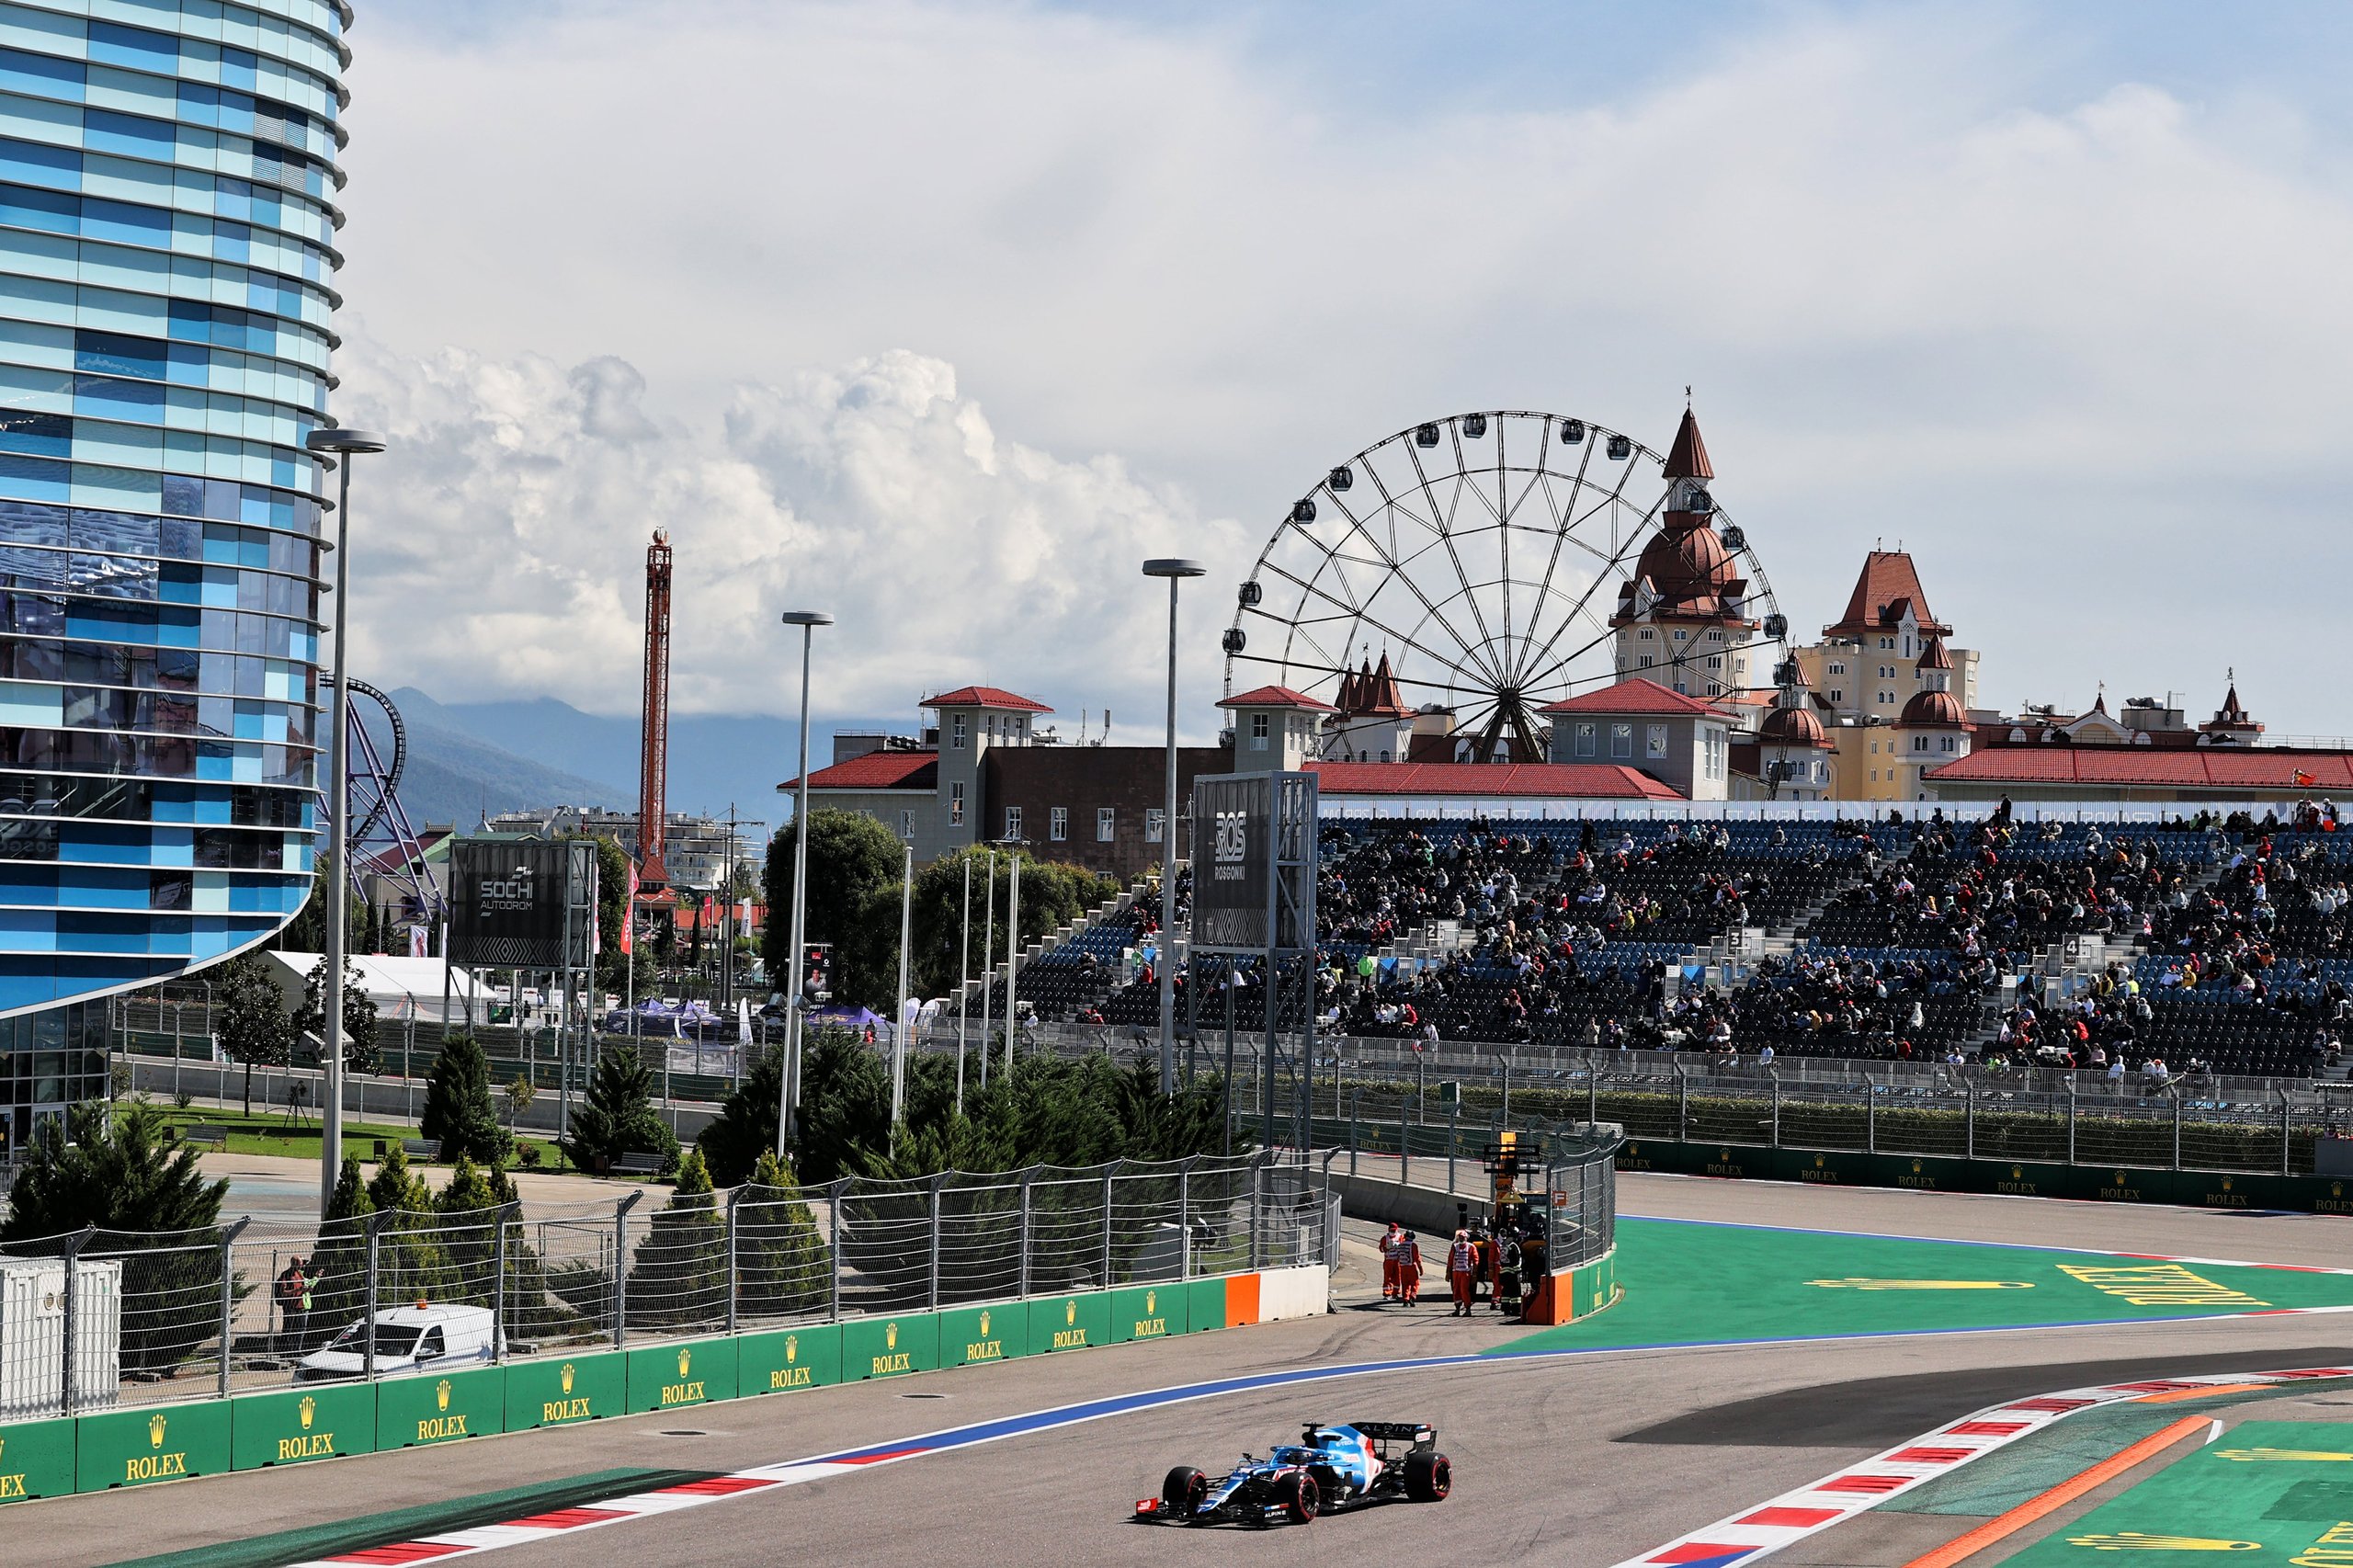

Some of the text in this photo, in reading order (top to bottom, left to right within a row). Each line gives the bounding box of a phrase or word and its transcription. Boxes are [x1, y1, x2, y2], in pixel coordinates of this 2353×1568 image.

[1214, 865, 1245, 881] ROSGONKI
[481, 881, 533, 899] SOCHI
[480, 900, 533, 911] AUTODROM
[1427, 925, 1436, 937] 2
[1731, 932, 1740, 945] 3
[2066, 939, 2077, 954] 4
[1360, 1141, 1391, 1152] ROLEX
[1616, 1158, 1651, 1169] ROLEX
[1707, 1164, 1743, 1176] ROLEX
[1802, 1169, 1837, 1181] ROLEX
[1898, 1176, 1936, 1187] ROLEX
[1998, 1181, 2036, 1193] ROLEX
[2100, 1187, 2140, 1199] ROLEX
[1554, 1192, 1565, 1204] F
[2207, 1194, 2247, 1206] ROLEX
[2055, 1264, 2274, 1306] ROLEX
[1134, 1318, 1165, 1336] ROLEX
[1053, 1328, 1086, 1348] ROLEX
[967, 1340, 1001, 1360] ROLEX
[872, 1353, 910, 1374] ROLEX
[770, 1367, 811, 1388] ROLEX
[662, 1381, 705, 1404] ROLEX
[543, 1397, 590, 1421] ROLEX
[418, 1415, 467, 1439] ROLEX
[278, 1433, 334, 1460] ROLEX
[126, 1452, 187, 1481] ROLEX
[1265, 1509, 1287, 1518] ALPINE
